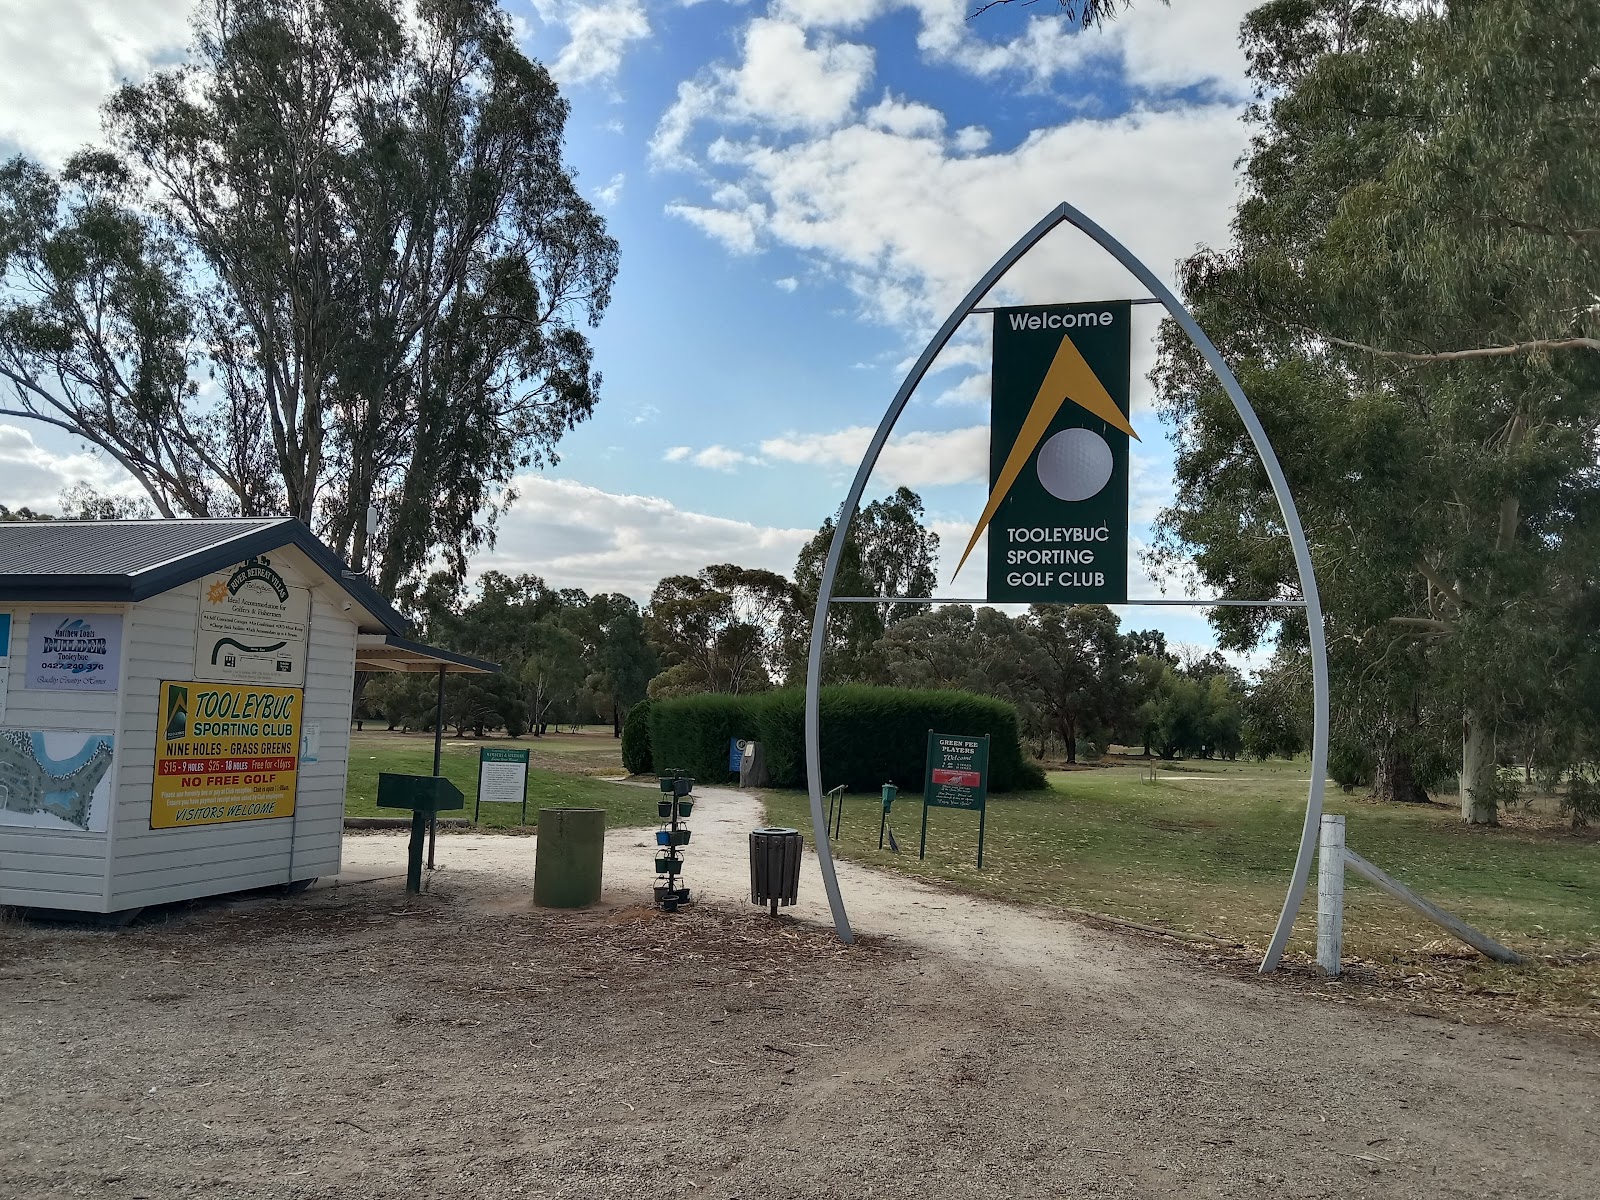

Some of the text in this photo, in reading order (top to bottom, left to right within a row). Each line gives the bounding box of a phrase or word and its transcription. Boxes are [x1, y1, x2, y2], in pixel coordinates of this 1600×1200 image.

[1009, 311, 1113, 331] Welcome
[1007, 527, 1109, 542] TOOLEYBUC
[1007, 550, 1094, 564] SPORTING
[230, 567, 286, 598] RIVER RETREAT VILLAS
[1007, 572, 1105, 586] GOLF CLUB
[245, 581, 272, 594] Tooleybuc
[228, 596, 240, 604] Ideal
[232, 605, 250, 613] Golfers
[258, 609, 282, 618] Fishermen
[55, 629, 78, 638] Matthew
[42, 636, 107, 655] BUILDER
[58, 653, 88, 662] Tooleybuc
[37, 676, 107, 686] Quality Country Homes
[196, 691, 295, 720] TOOLEYBUC
[194, 722, 259, 737] SPORTING
[262, 723, 293, 736] CLUB
[166, 743, 190, 756] NINE
[192, 743, 222, 756] HOLES
[230, 743, 259, 755] GRASS
[261, 742, 292, 754] GREENS
[941, 746, 975, 754] PLAYERS
[164, 761, 177, 774] $15
[182, 761, 187, 771] 9
[188, 763, 204, 772] HOLES
[208, 760, 220, 771] $25
[225, 760, 232, 771] 18
[233, 762, 248, 771] HOLES
[252, 759, 264, 769] Free
[265, 759, 273, 769] for
[273, 759, 291, 770] <16yrs
[181, 774, 276, 787] NO FREE GOLF
[175, 802, 276, 821] VISITORS WELCOME
